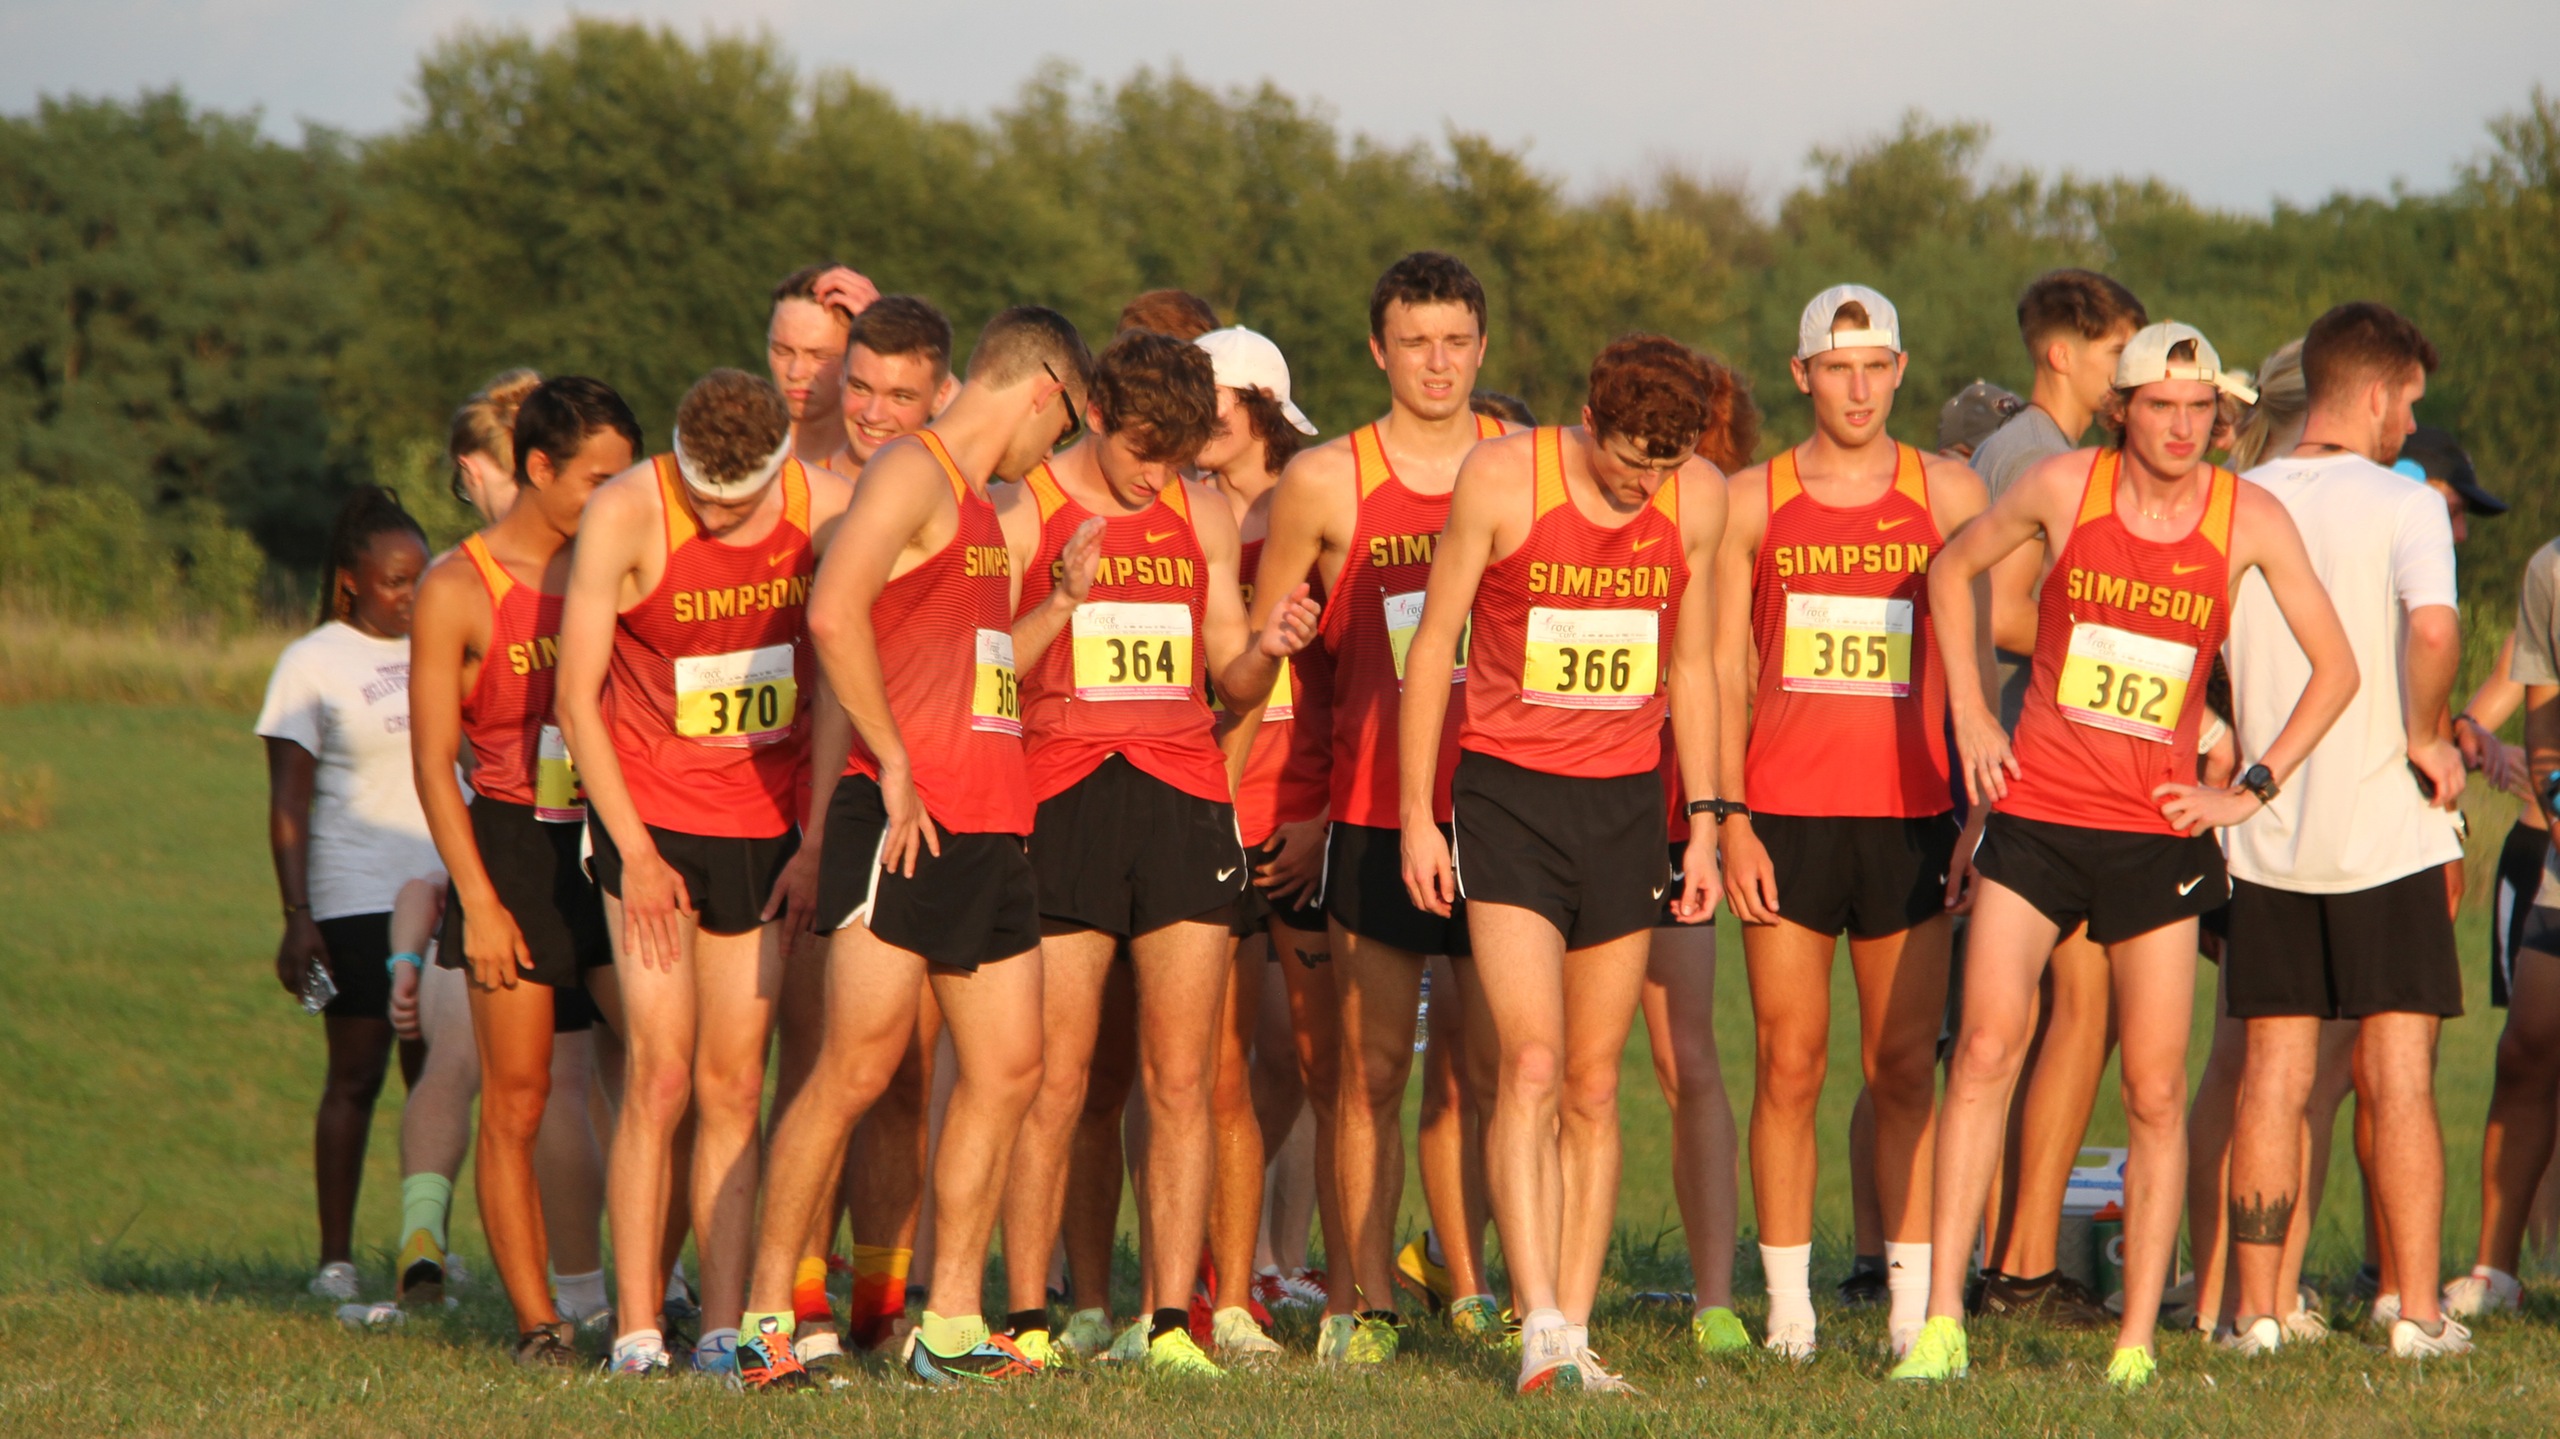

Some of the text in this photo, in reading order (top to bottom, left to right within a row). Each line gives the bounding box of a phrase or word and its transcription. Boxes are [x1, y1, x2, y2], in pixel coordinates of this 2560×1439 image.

[1051, 556, 1194, 588] SMPSON
[1528, 561, 1671, 598] SIMPSON
[1775, 543, 1929, 577] SIMPSON
[673, 575, 808, 623] SIMPSON
[2067, 567, 2214, 630] SIMPSON
[1106, 638, 1174, 683] 364
[1556, 647, 1631, 692] 366
[1813, 632, 1887, 679] 365
[709, 684, 778, 734] 370
[2088, 664, 2169, 724] 362
